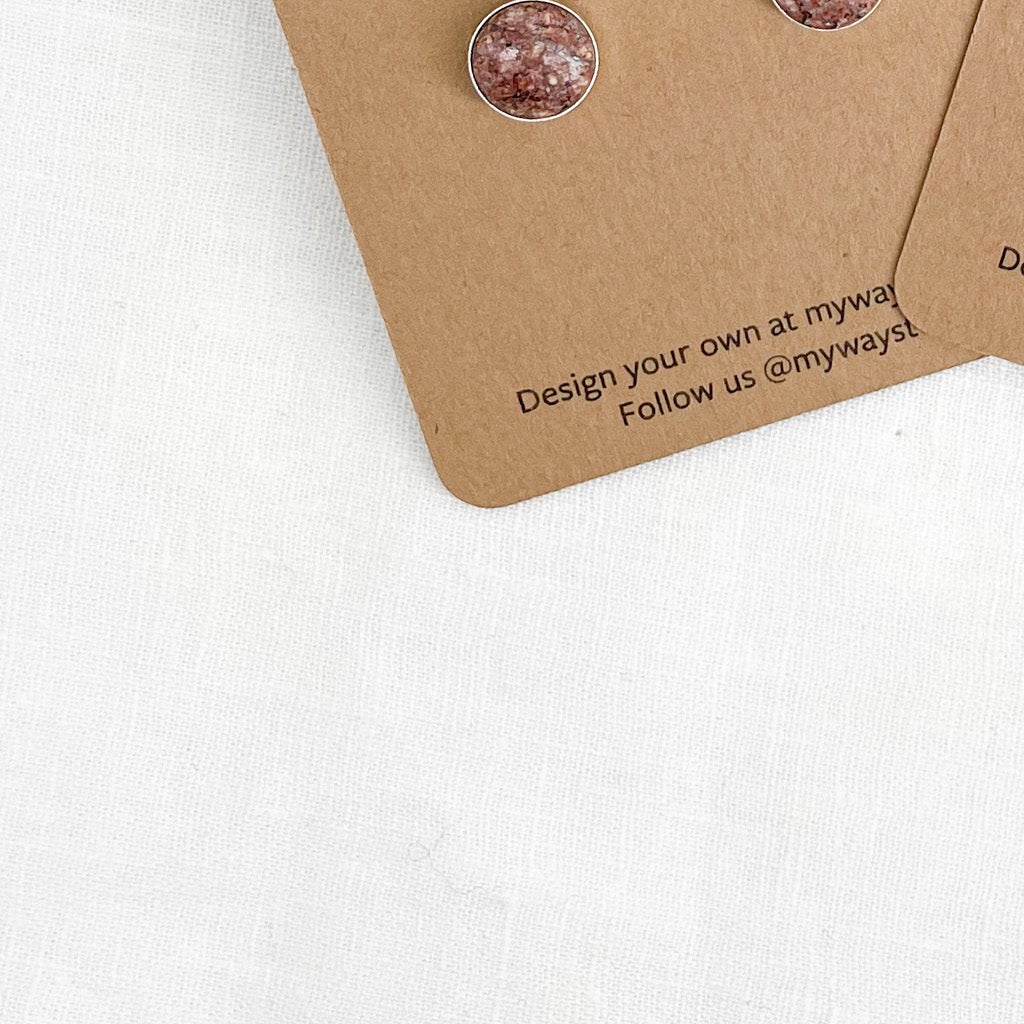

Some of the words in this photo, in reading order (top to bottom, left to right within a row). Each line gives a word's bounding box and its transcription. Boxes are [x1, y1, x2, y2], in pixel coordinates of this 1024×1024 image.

[515, 369, 618, 414] Design
[622, 344, 690, 390] your
[700, 324, 762, 357] own
[767, 310, 799, 337] at
[618, 382, 714, 427] Follow
[723, 369, 757, 395] us
